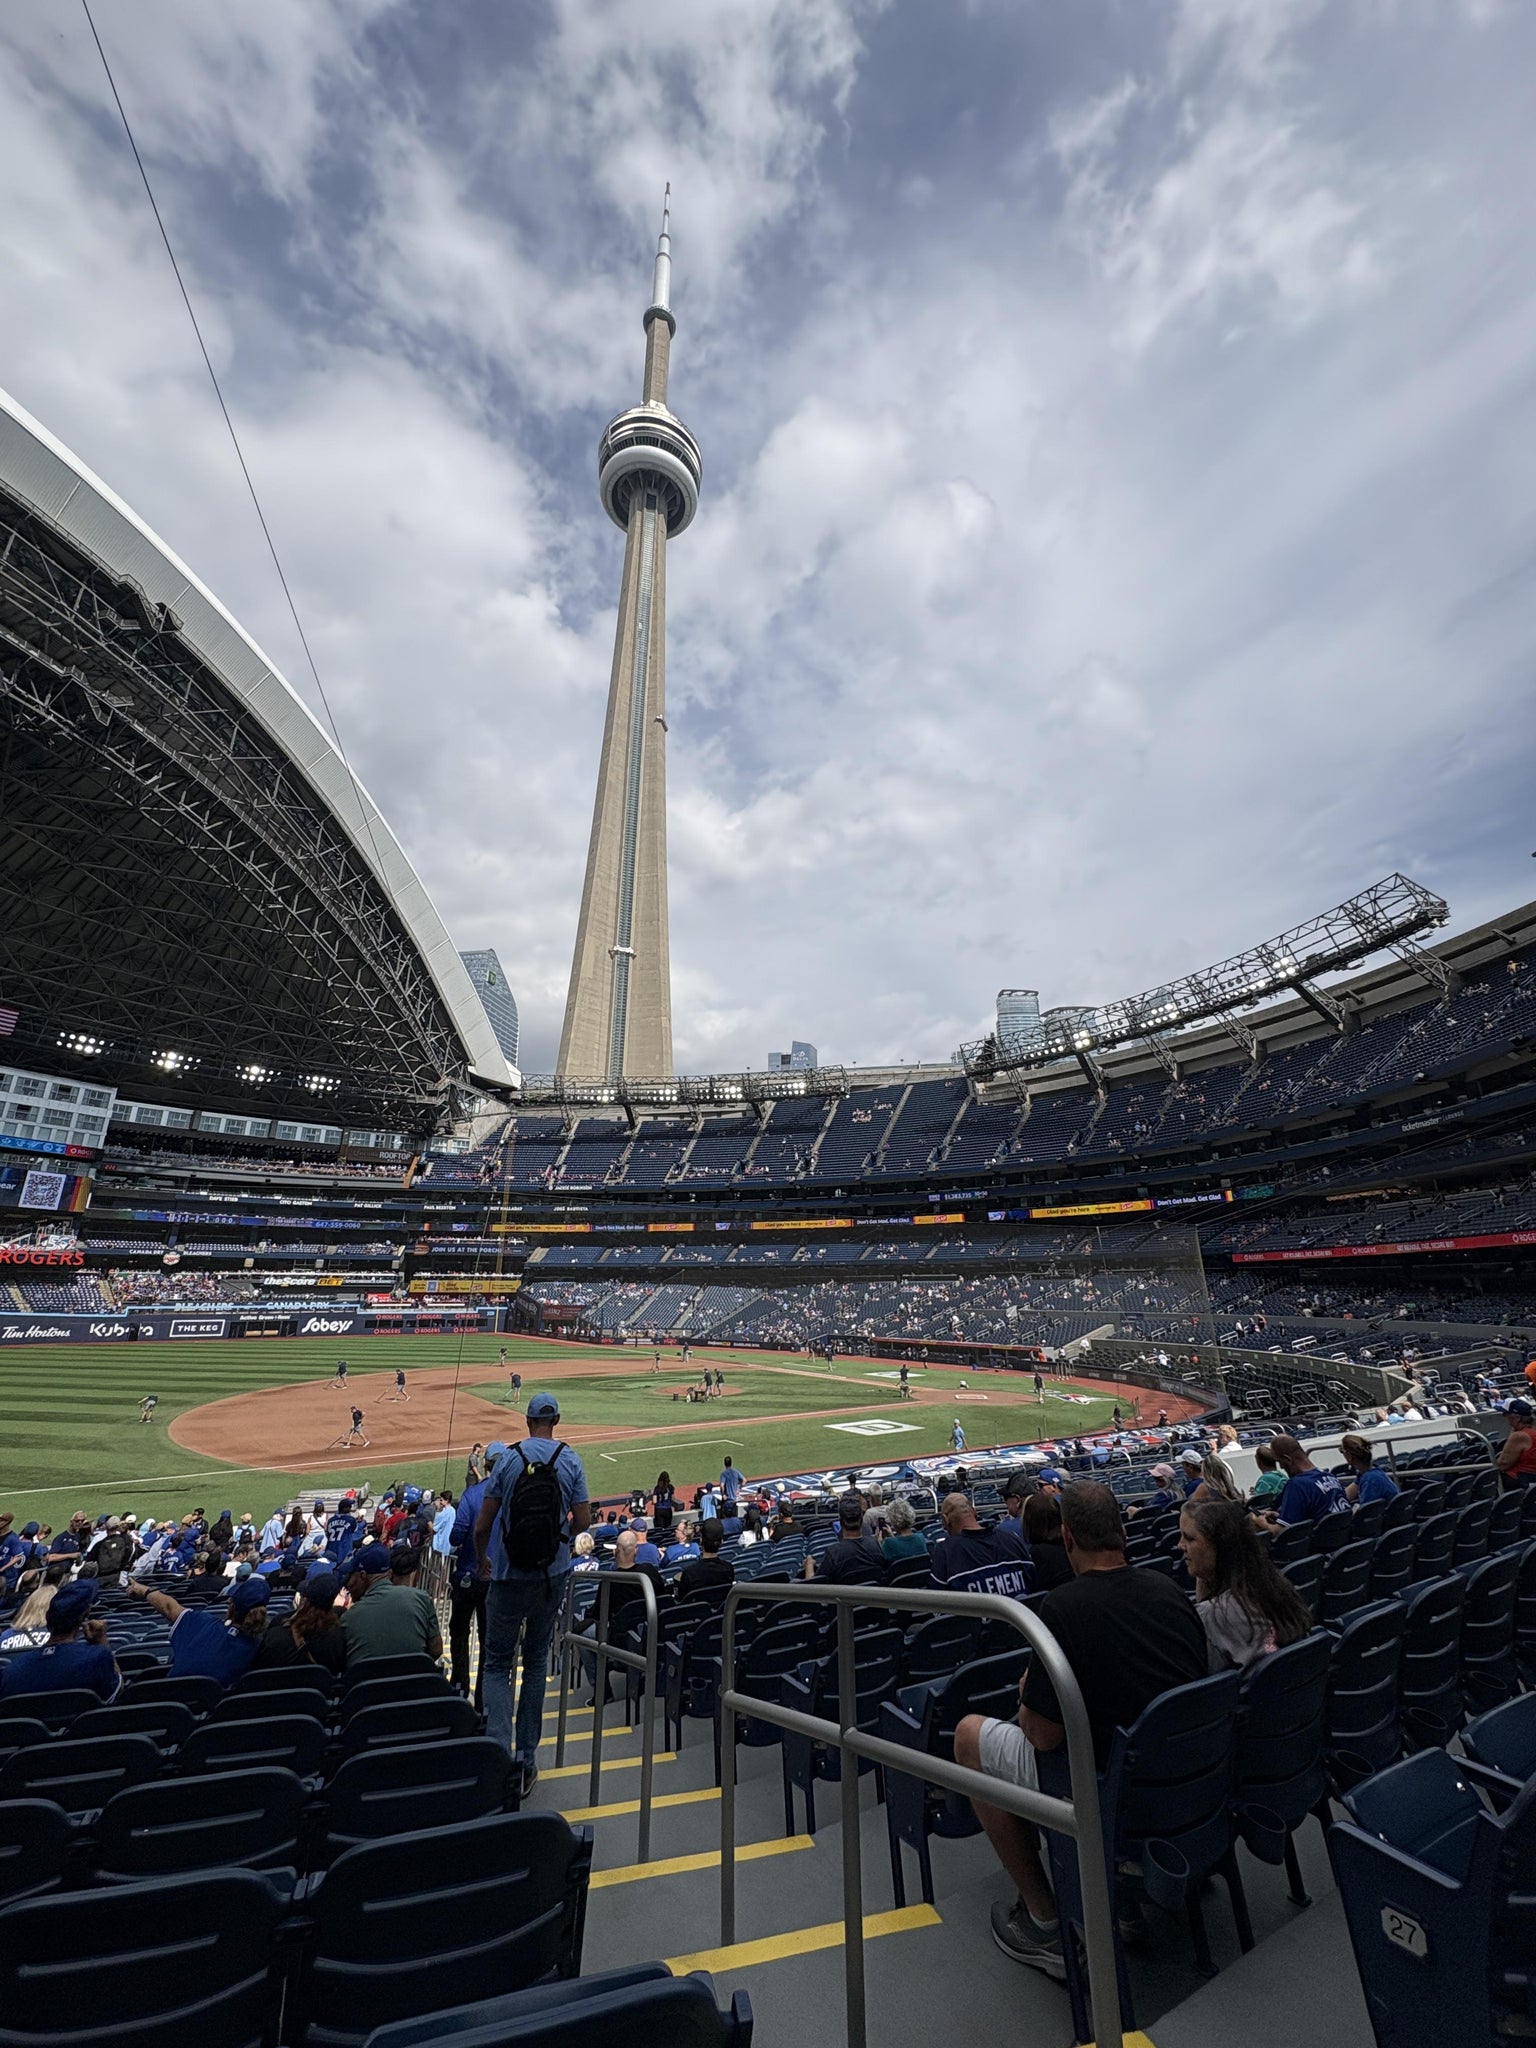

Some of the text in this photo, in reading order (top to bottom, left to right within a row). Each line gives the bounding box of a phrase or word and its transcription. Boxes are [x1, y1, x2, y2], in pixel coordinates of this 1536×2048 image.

[1402, 1117, 1440, 1132] ticketmaster
[379, 1151, 411, 1160] ROOFTOP
[0, 1250, 85, 1266] ROGERS
[264, 1277, 315, 1286] theScore
[1, 1325, 71, 1339] Tim Hortons
[89, 1322, 154, 1337] Kuba
[301, 1316, 354, 1334] Sobeys
[329, 1527, 346, 1541] 27
[967, 1570, 1026, 1595] CLEMENT
[1390, 1914, 1417, 1945] 27
